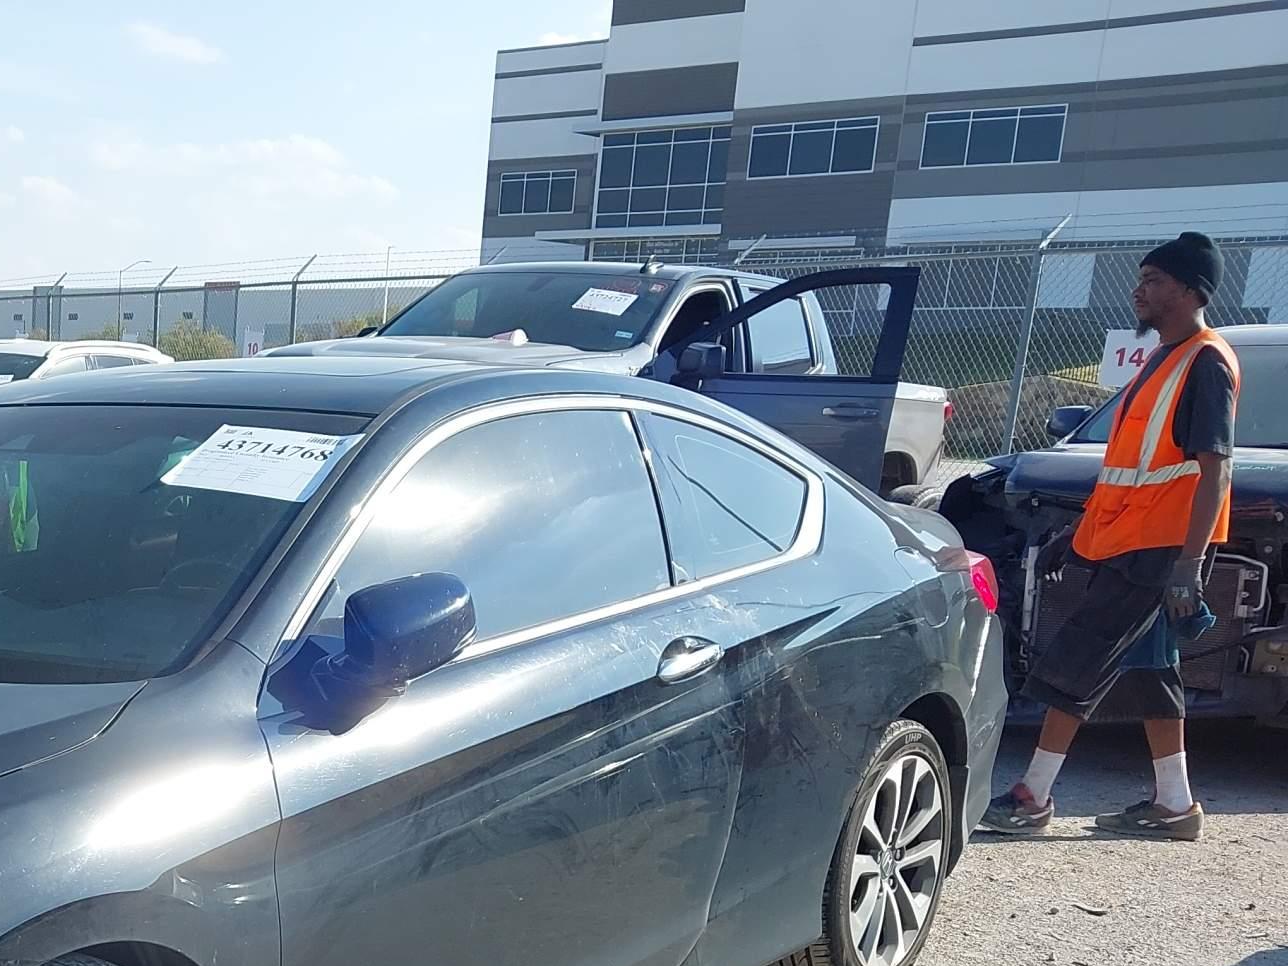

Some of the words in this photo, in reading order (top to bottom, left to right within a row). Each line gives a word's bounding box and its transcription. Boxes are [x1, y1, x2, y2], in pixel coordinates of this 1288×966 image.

[248, 342, 259, 355] 10
[1115, 347, 1145, 367] 14
[216, 438, 334, 462] 43714768
[904, 732, 922, 745] UHP
